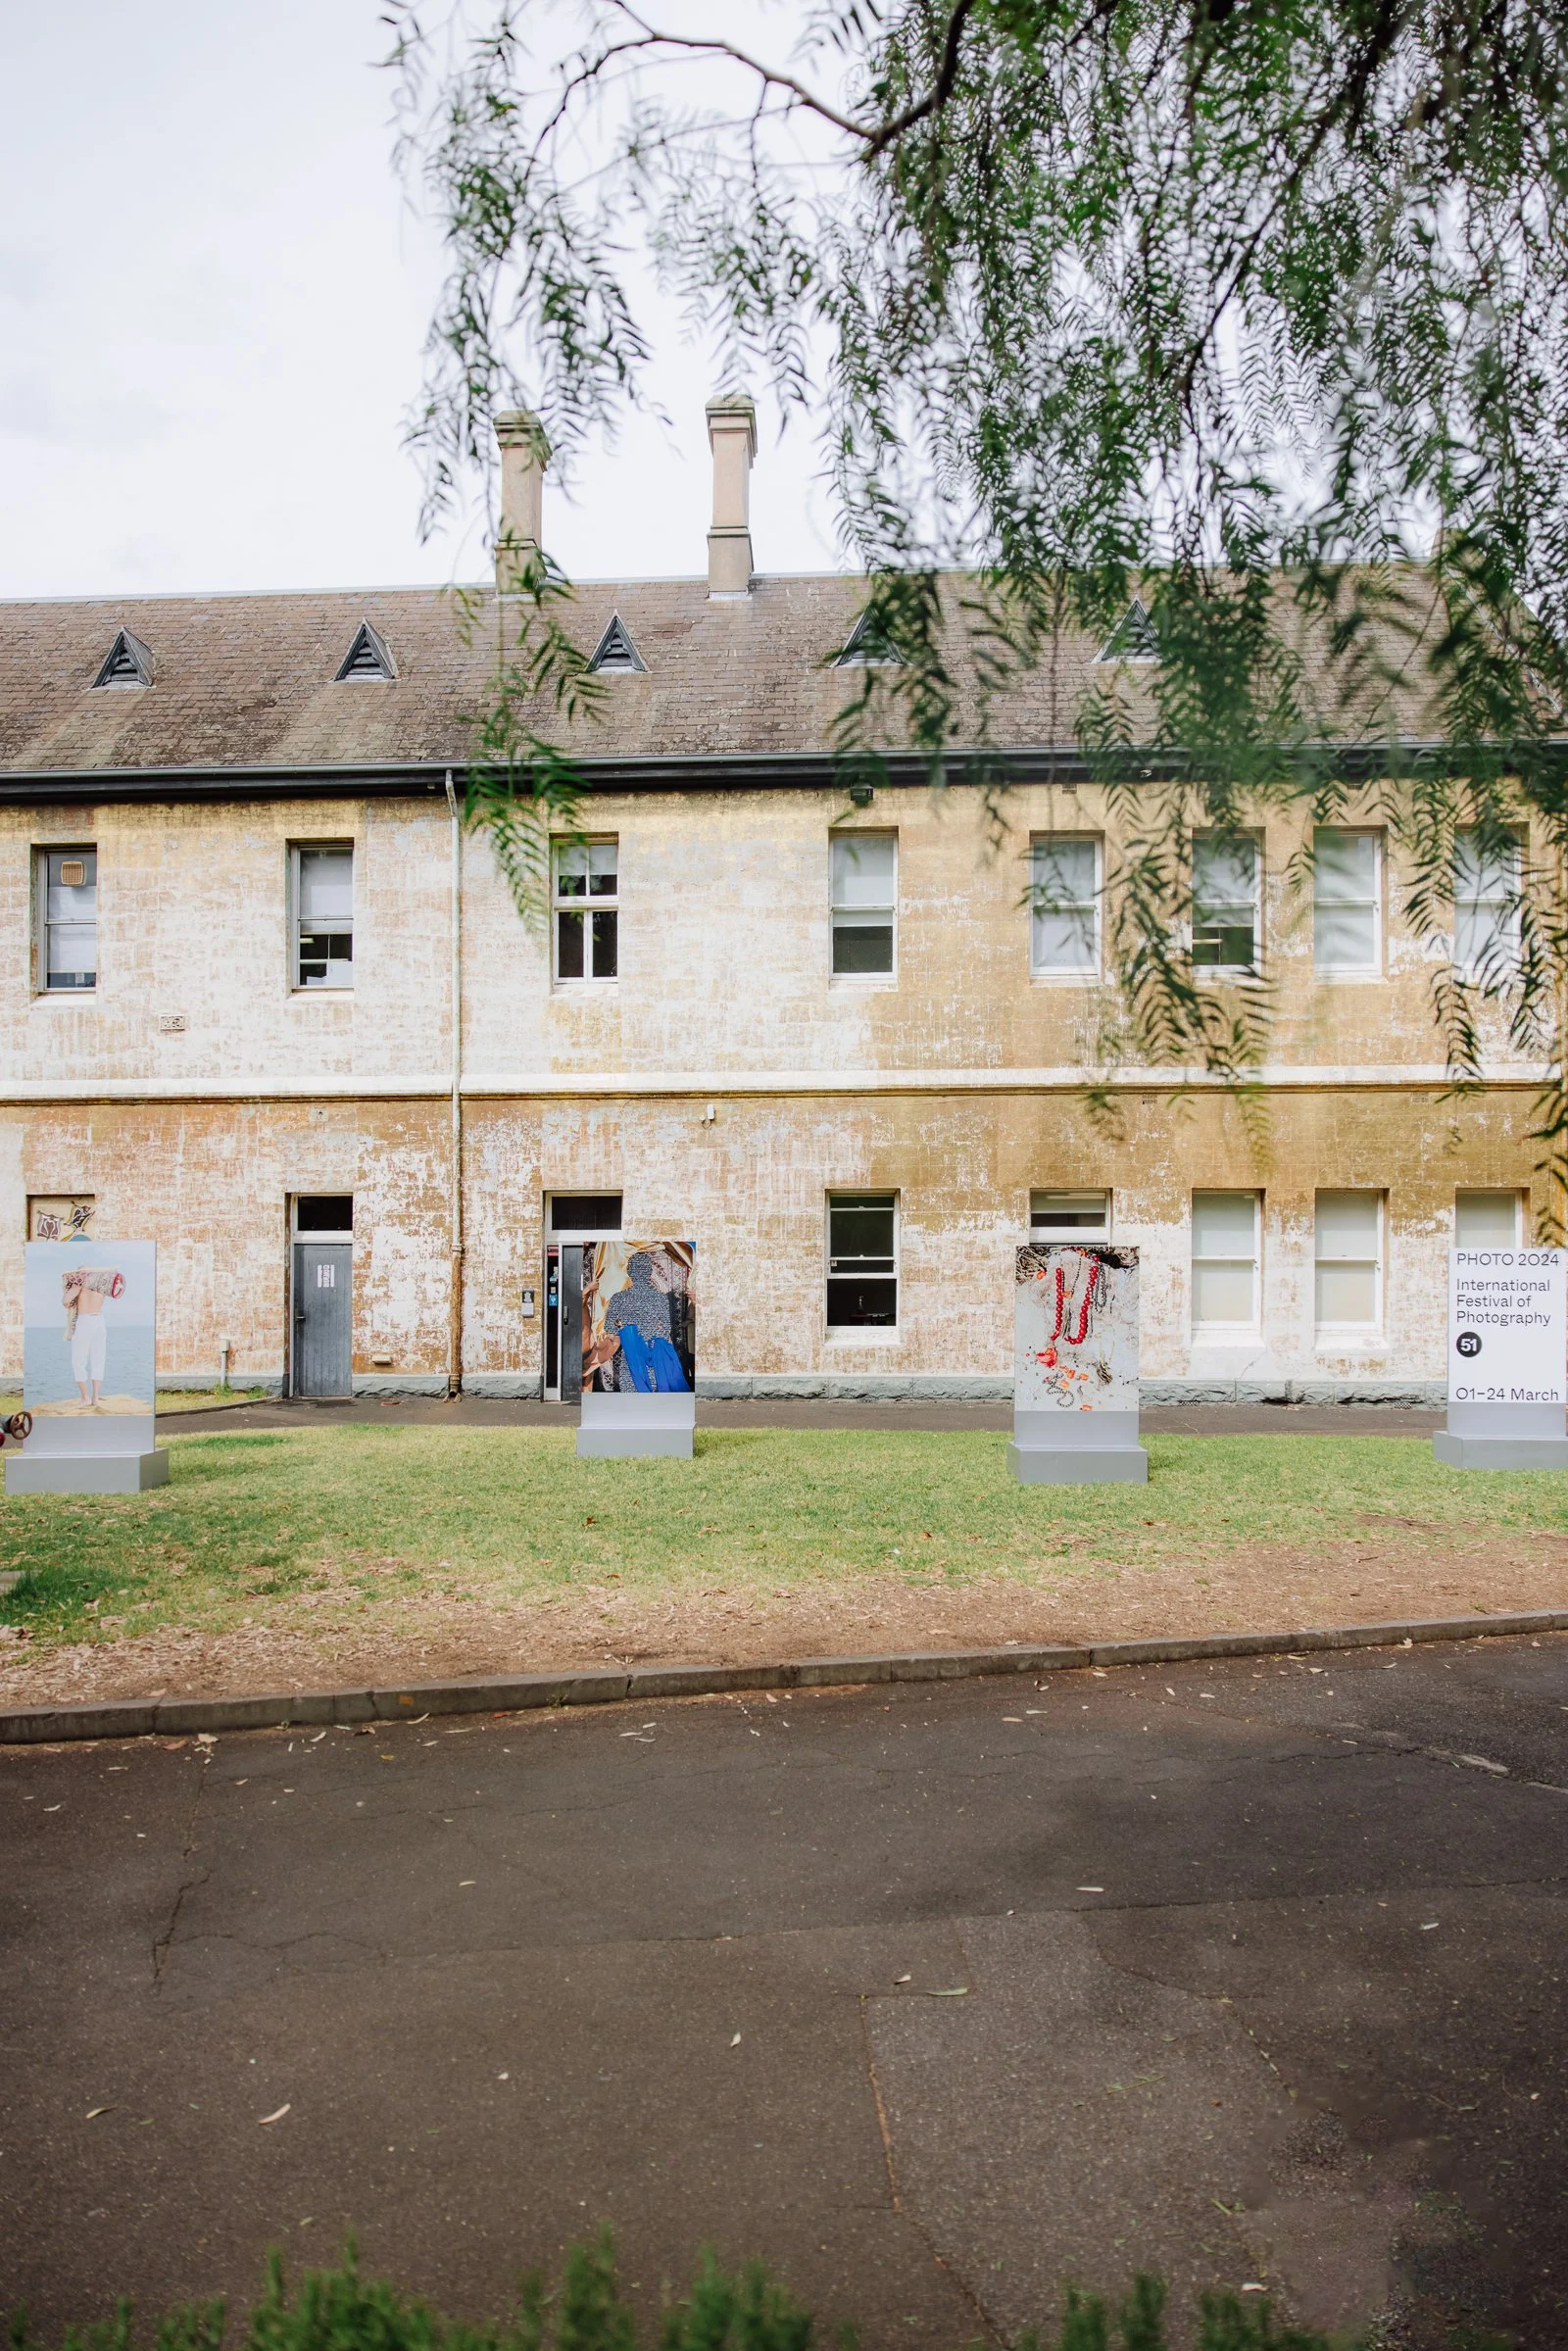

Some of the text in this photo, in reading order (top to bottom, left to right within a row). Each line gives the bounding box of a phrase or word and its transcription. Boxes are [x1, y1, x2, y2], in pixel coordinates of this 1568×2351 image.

[1457, 1252, 1559, 1266] PHOTO 2024
[1456, 1278, 1550, 1292] International
[1456, 1294, 1532, 1307] Festival of
[1456, 1310, 1551, 1327] Photography
[1460, 1338, 1478, 1352] 51
[1510, 1388, 1559, 1401] March
